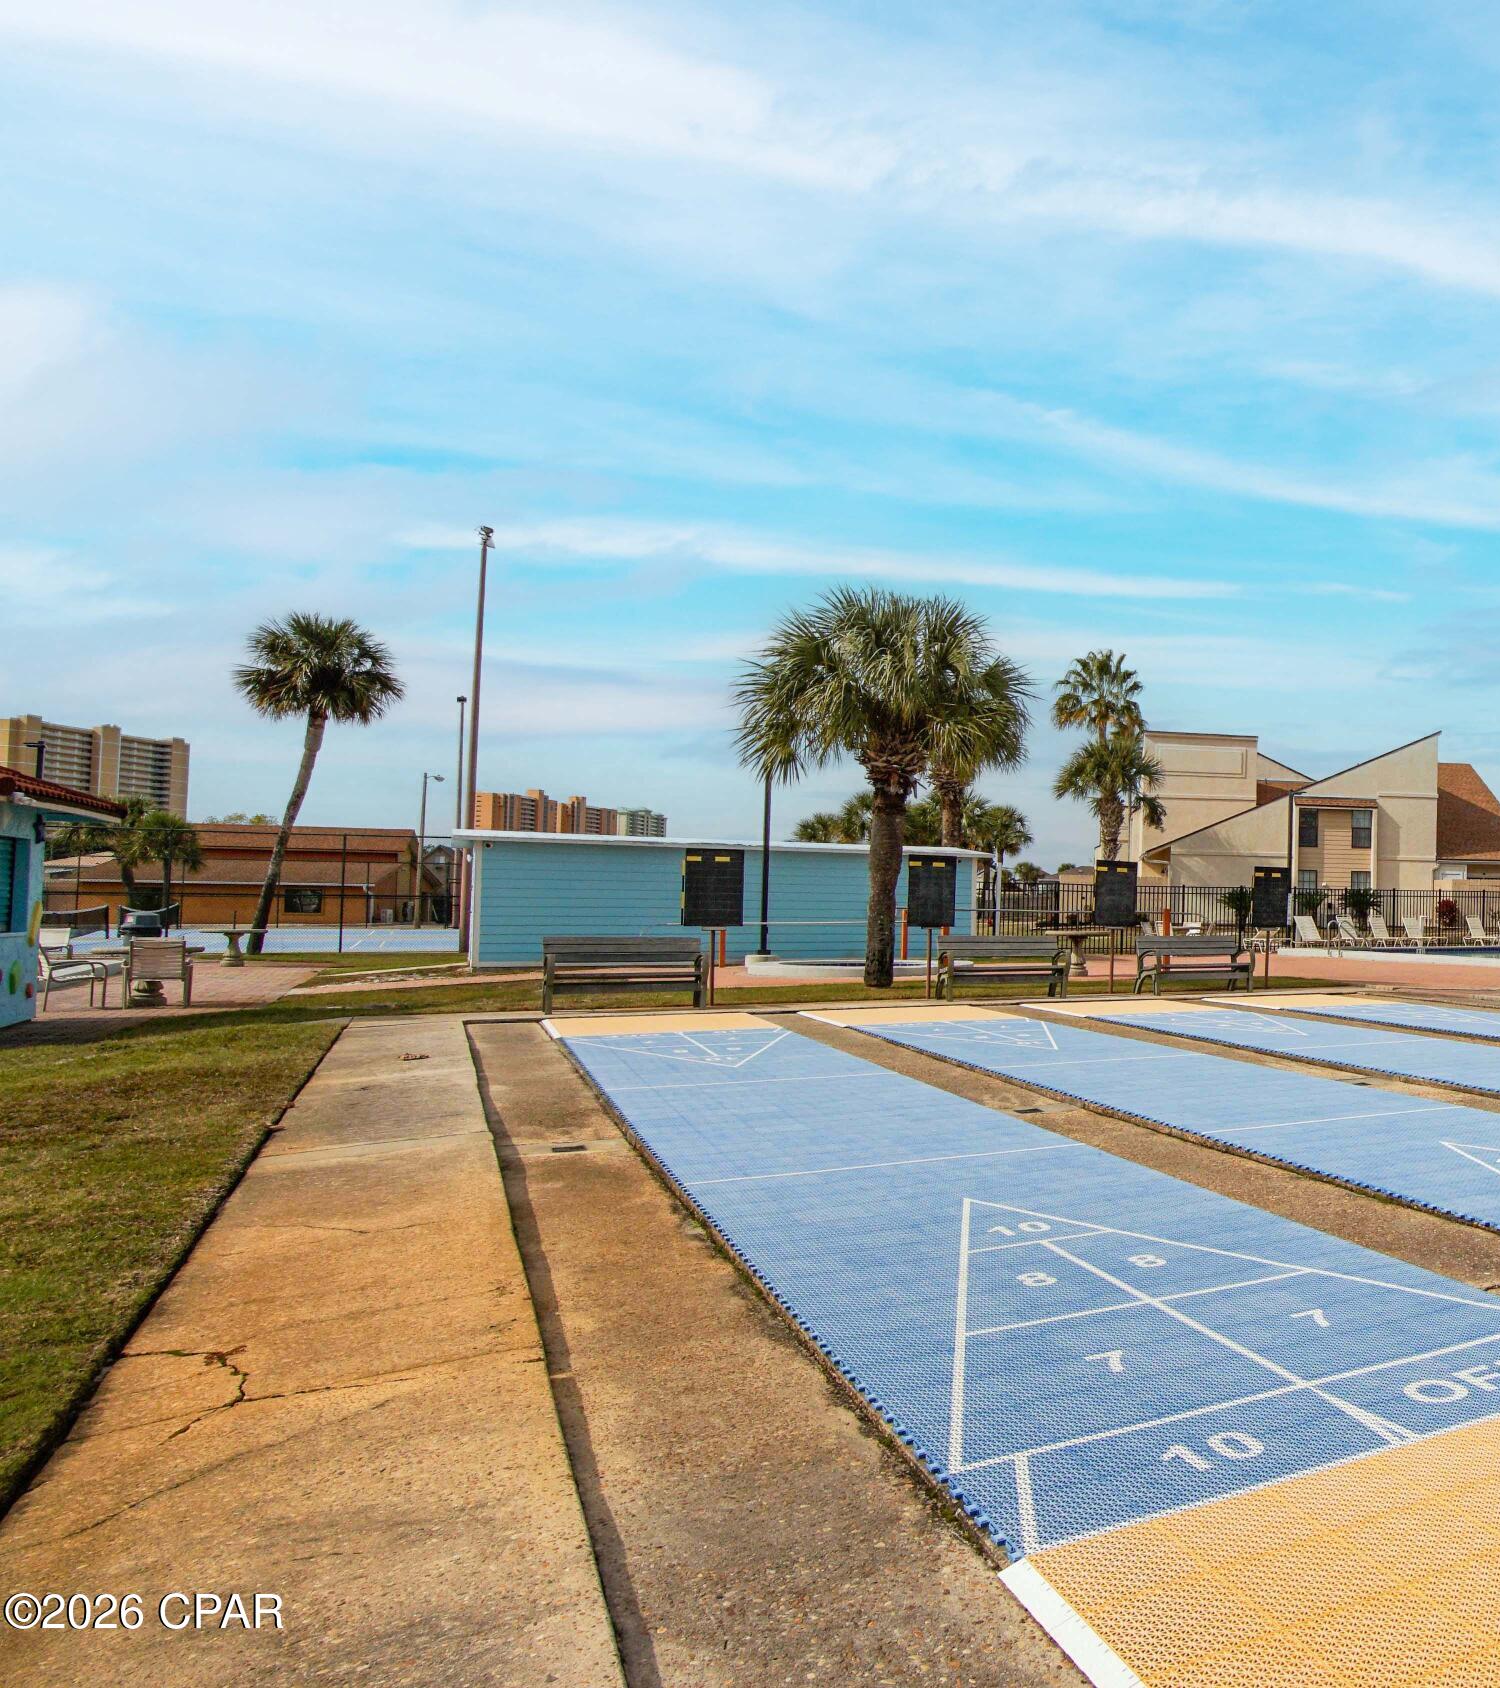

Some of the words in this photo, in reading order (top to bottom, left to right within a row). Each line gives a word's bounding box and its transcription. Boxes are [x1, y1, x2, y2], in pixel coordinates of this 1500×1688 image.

[988, 1221, 1051, 1236] 10
[1127, 1254, 1167, 1268] 8
[1016, 1271, 1057, 1287] 8
[1289, 1308, 1330, 1328] 7
[1084, 1350, 1126, 1373] 7
[1160, 1431, 1265, 1471] 10
